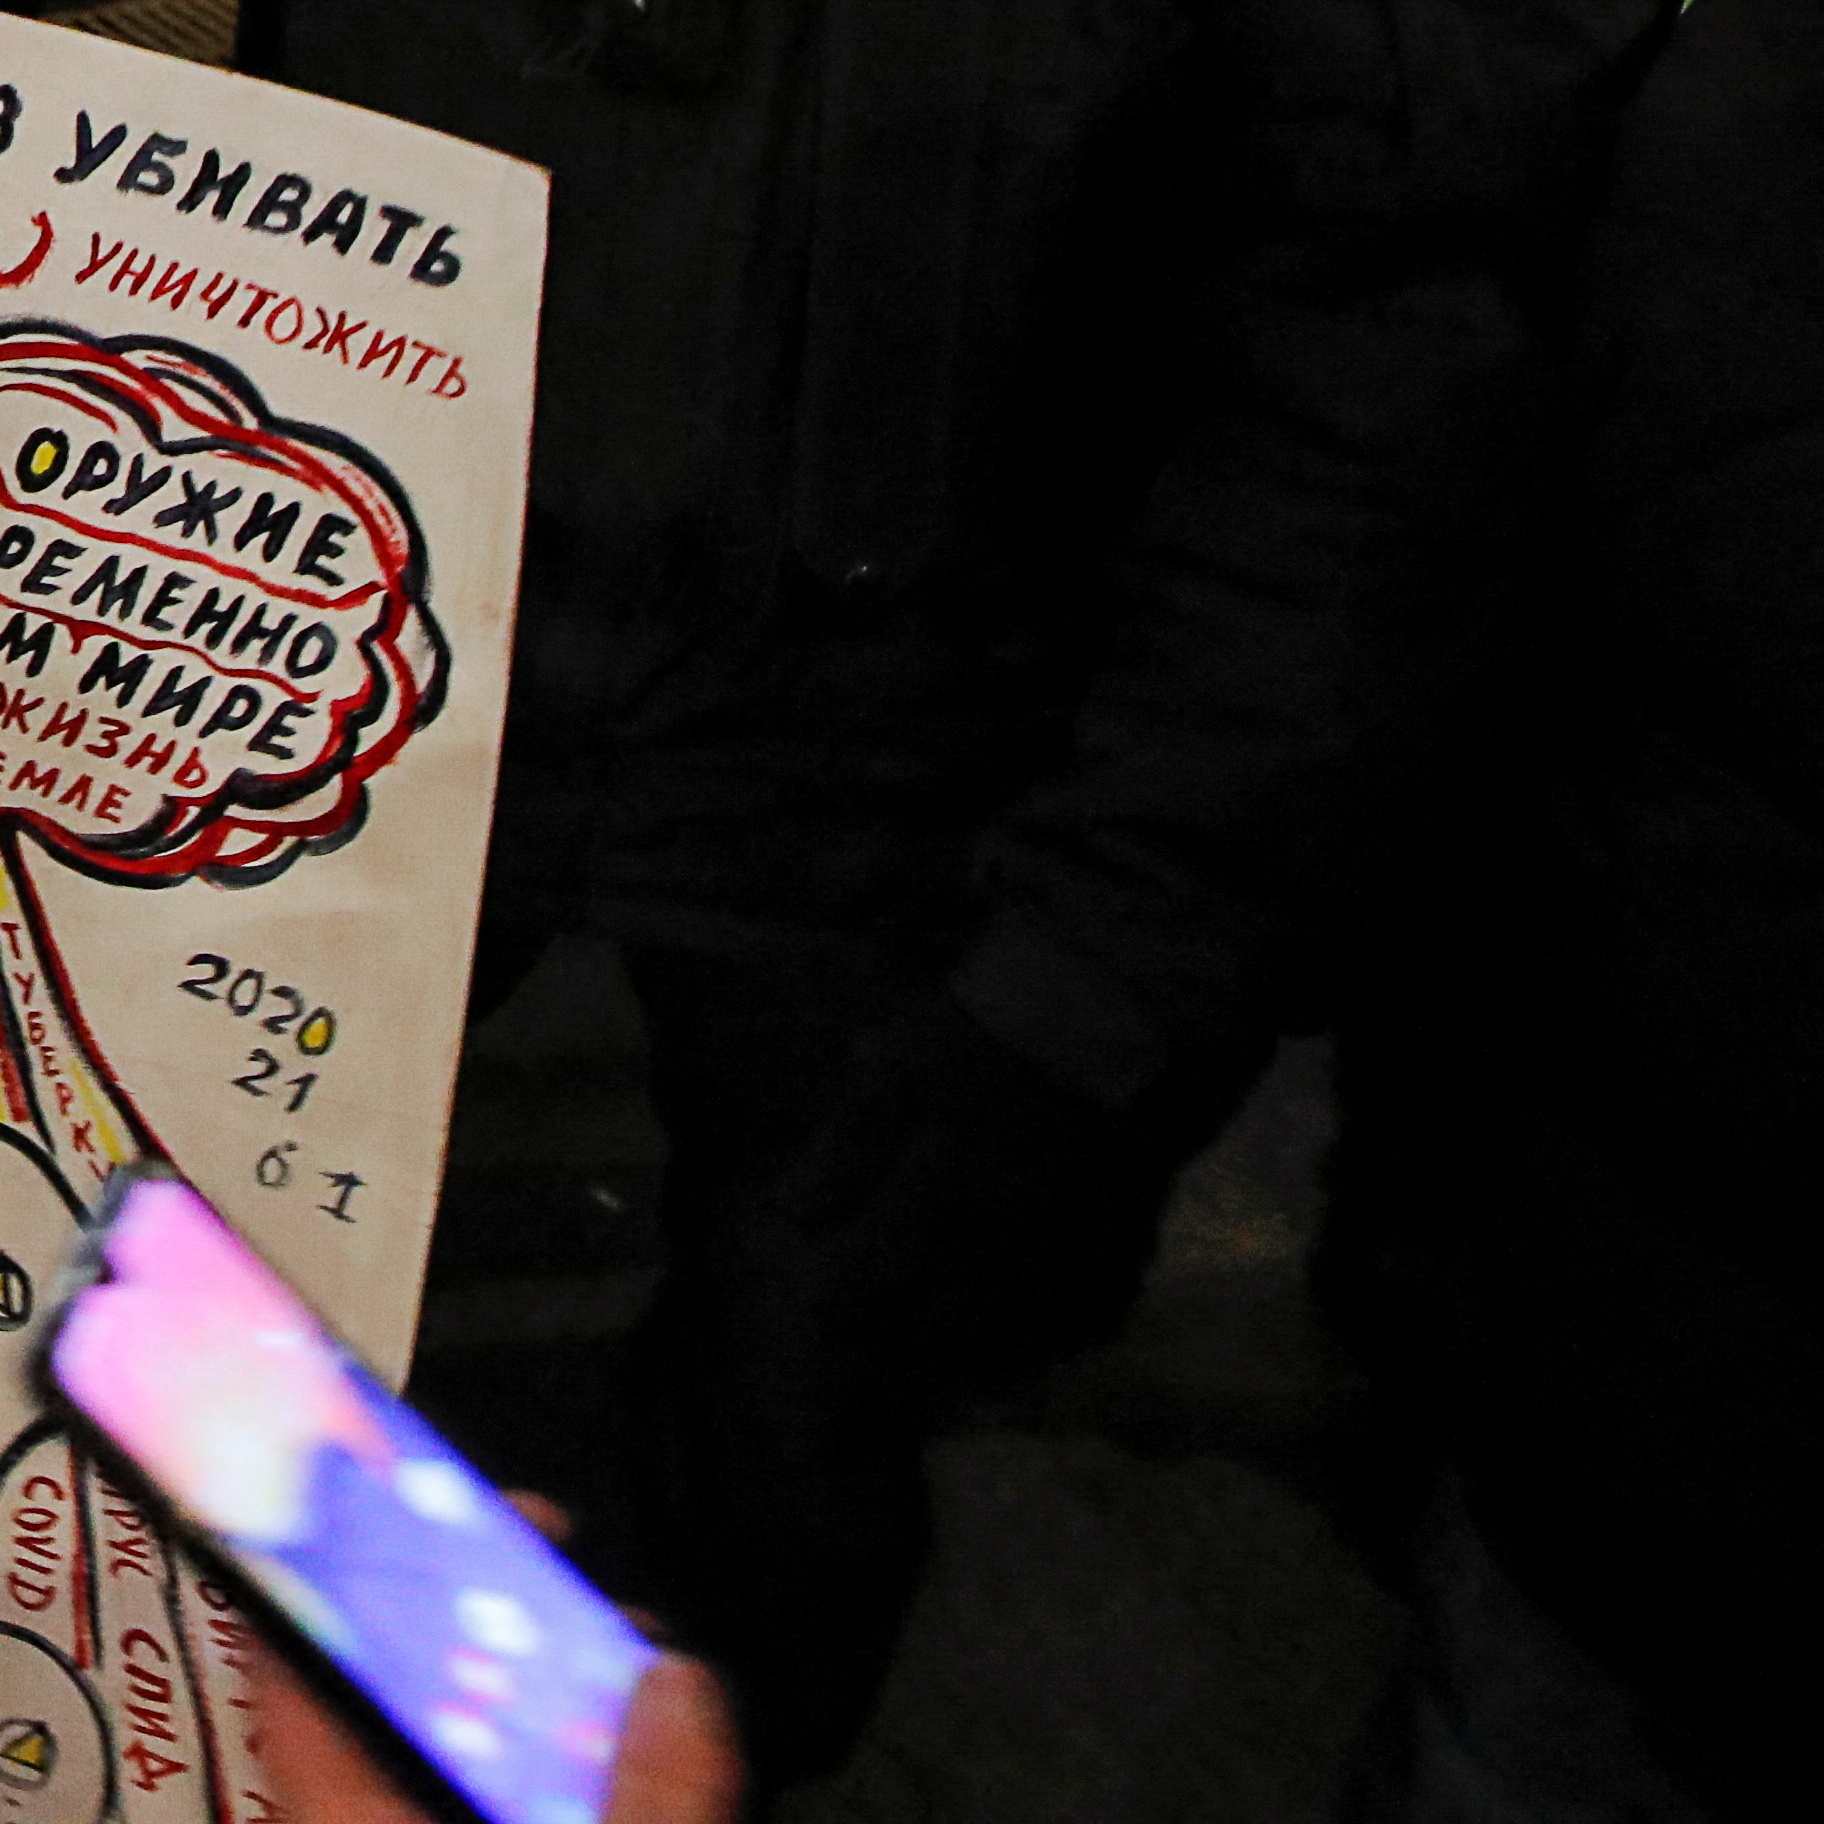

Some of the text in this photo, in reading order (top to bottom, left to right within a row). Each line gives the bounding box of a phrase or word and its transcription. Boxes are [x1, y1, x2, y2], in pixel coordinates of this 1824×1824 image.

[53, 109, 461, 287] УБИВАТЬ
[74, 232, 468, 401] УНИЧТОЖИТЬ
[14, 427, 359, 588] ОРУЖИЕ
[79, 631, 320, 761] МИРЕ
[178, 953, 337, 1056] 2020
[231, 1048, 320, 1114] 21
[8, 1476, 66, 1612] COVID
[120, 1628, 189, 1791] СПИД
